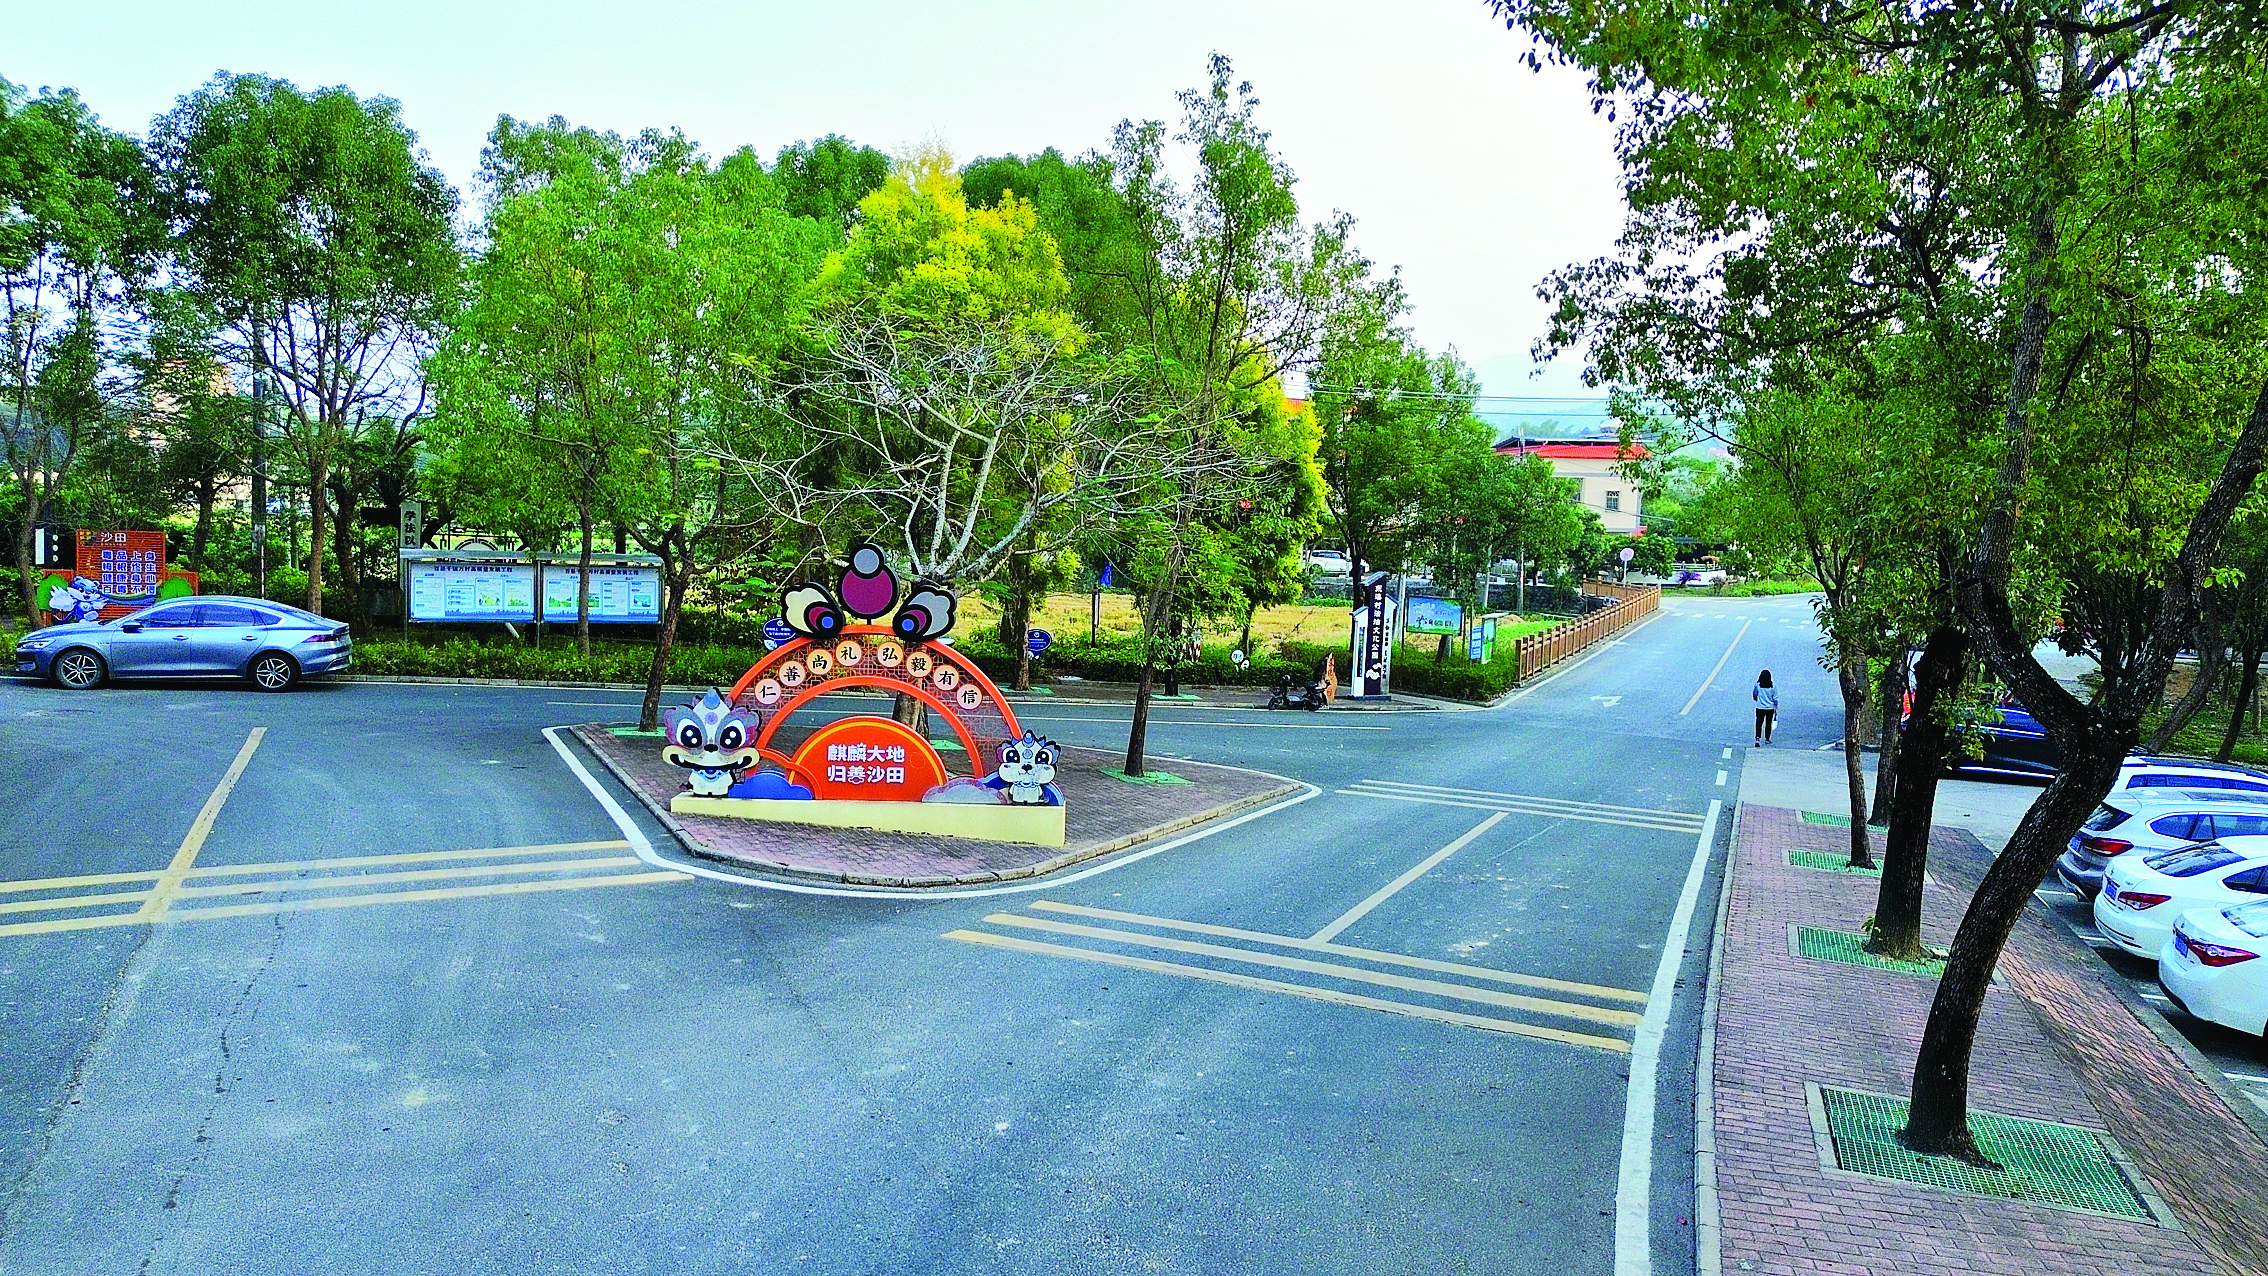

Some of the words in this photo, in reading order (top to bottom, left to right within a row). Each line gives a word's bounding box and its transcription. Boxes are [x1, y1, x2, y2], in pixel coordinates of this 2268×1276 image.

[100, 531, 127, 543] 沙田
[101, 549, 157, 561] 毒品上身
[101, 561, 157, 572] 悔恨终生
[101, 572, 157, 584] 健康身心
[101, 583, 157, 595] 百毒不侵
[827, 742, 905, 763] 麒麟大地
[827, 764, 905, 784] 归善沙田
